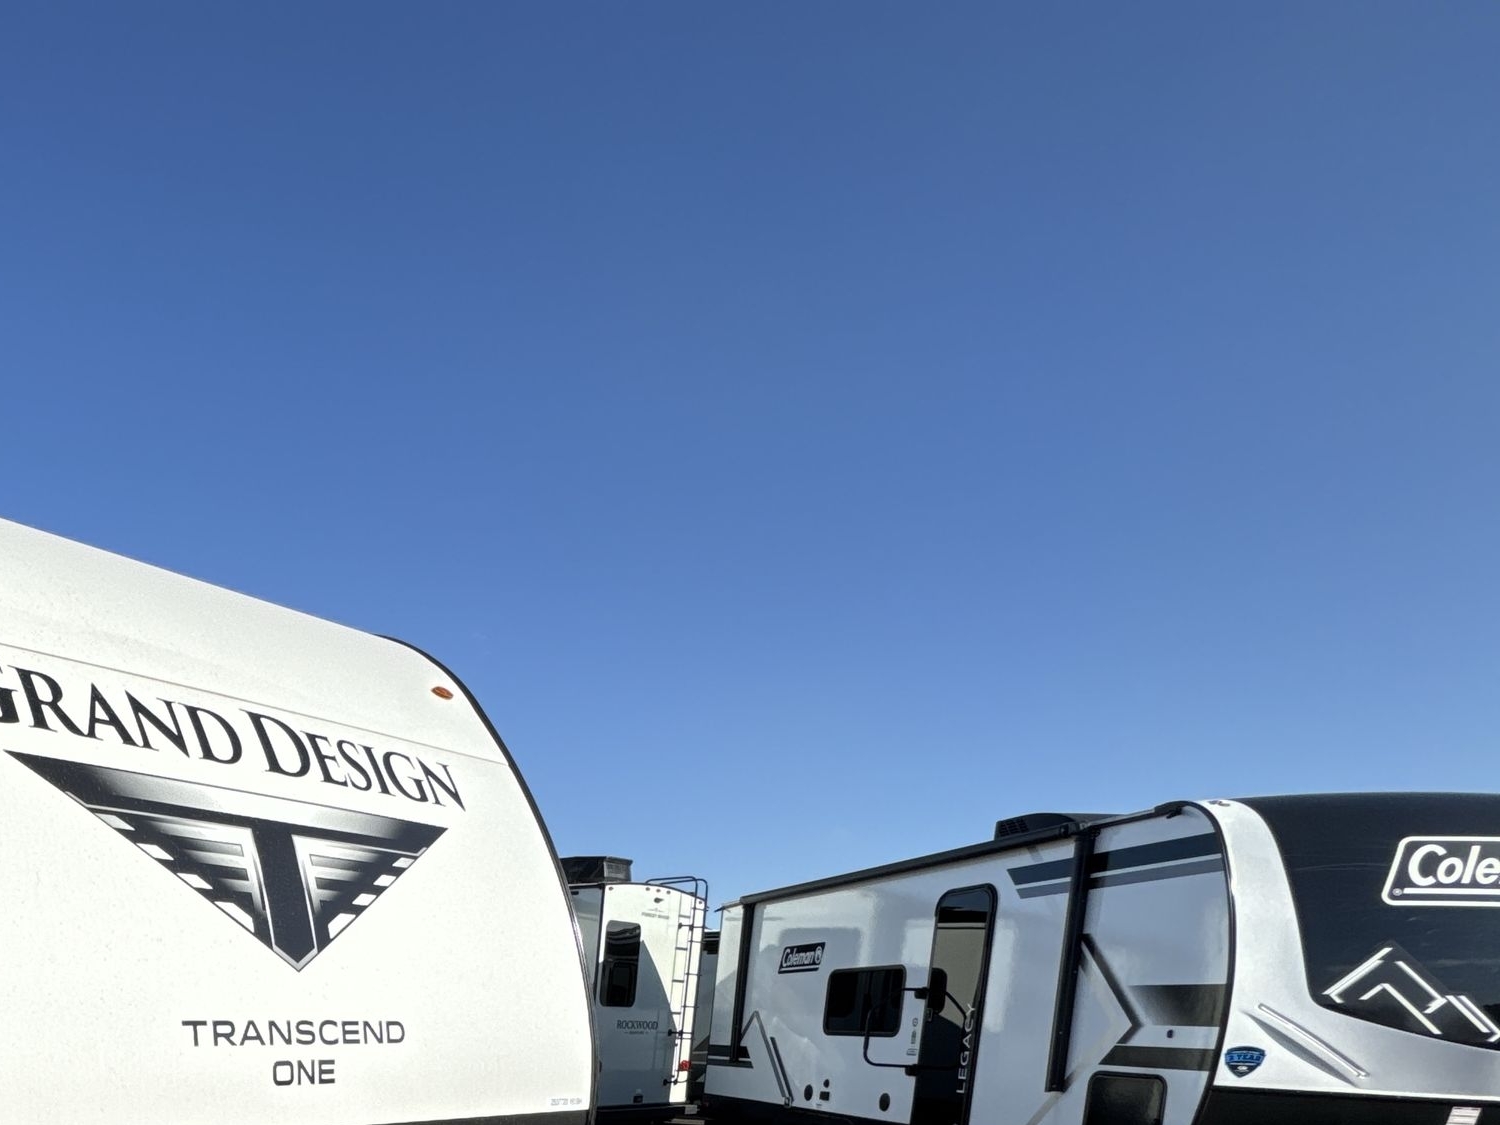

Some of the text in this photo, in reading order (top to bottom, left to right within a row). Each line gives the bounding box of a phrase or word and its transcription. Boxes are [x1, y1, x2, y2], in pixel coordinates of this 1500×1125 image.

[239, 708, 467, 811] DESIGN
[782, 947, 815, 967] Coleman
[181, 1020, 406, 1047] TRANSCEND
[616, 1020, 659, 1030] ROCKWOOD
[956, 1004, 975, 1093] LEGACY
[272, 1059, 336, 1086] ONE
